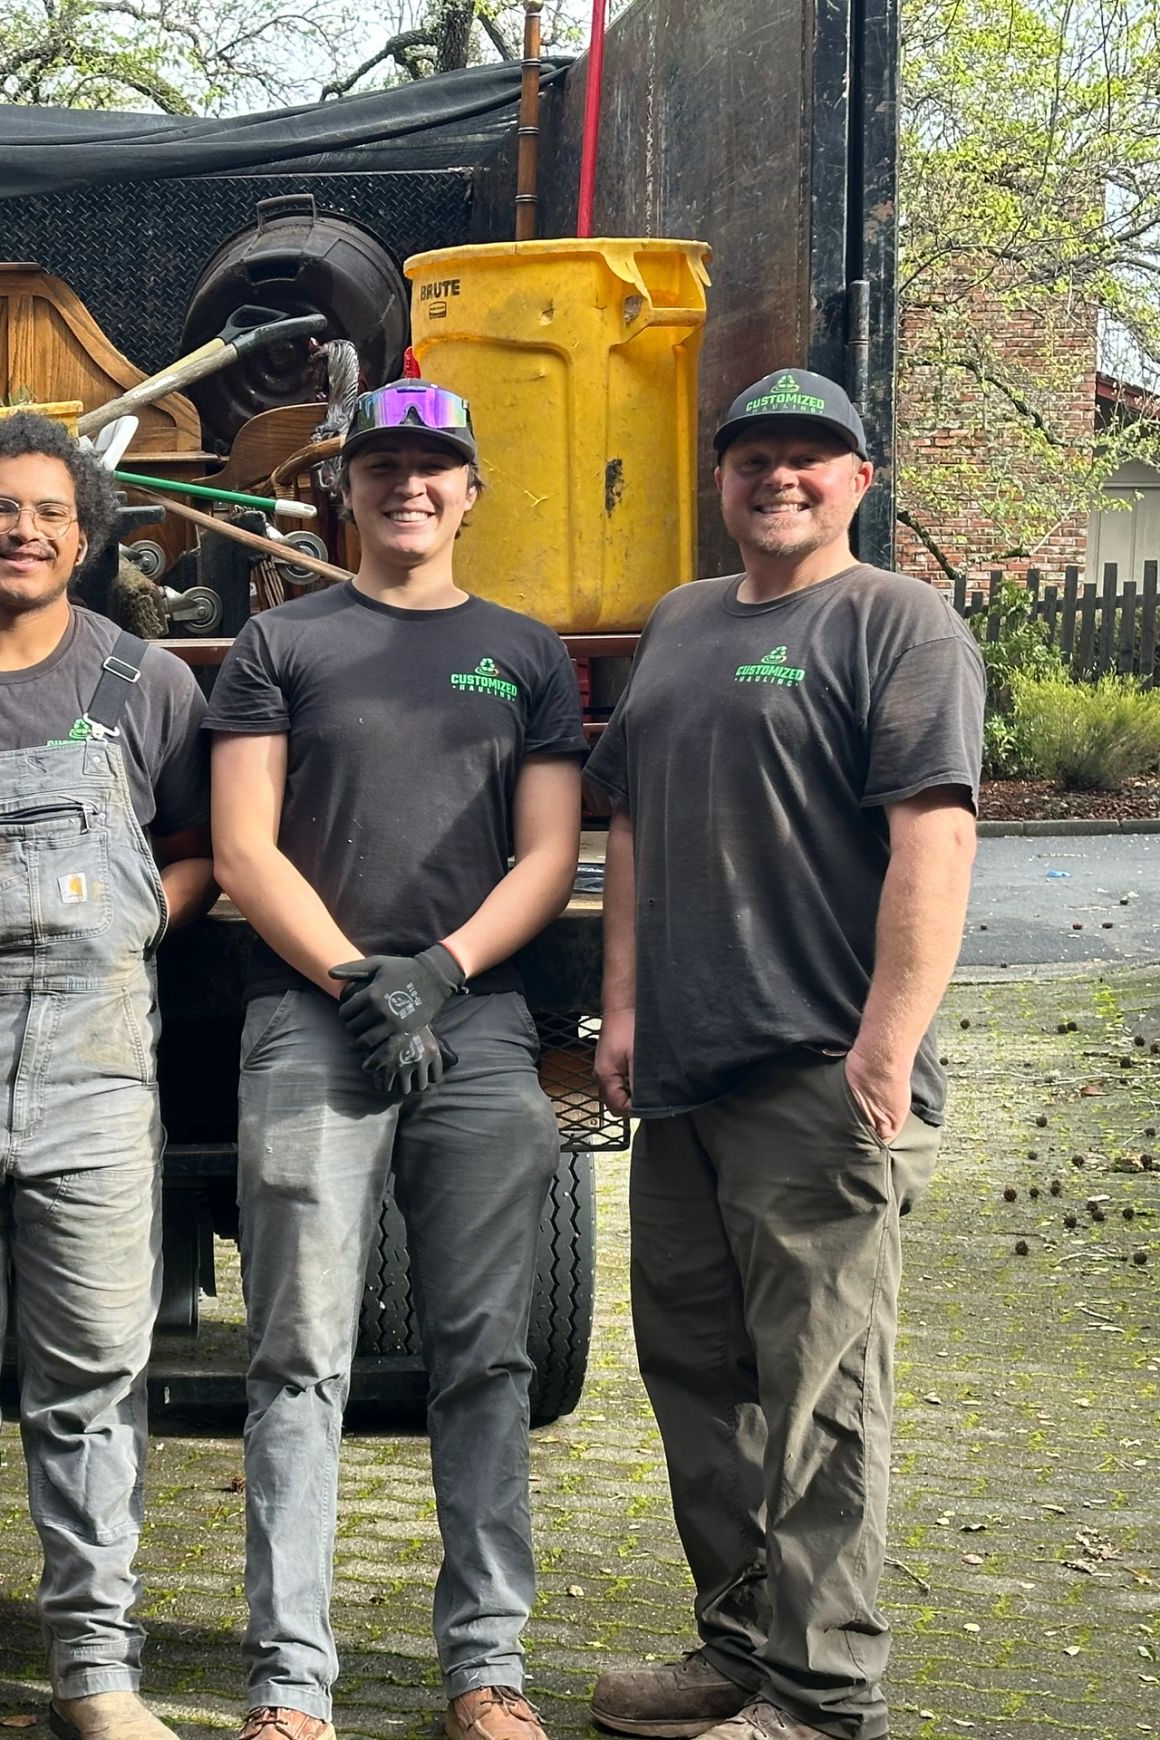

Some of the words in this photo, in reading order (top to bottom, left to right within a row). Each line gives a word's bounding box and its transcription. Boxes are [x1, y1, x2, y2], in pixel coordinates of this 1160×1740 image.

[420, 279, 460, 301] BRUTE
[746, 394, 825, 412] CUSTOMIZED
[735, 665, 806, 681] CUSTOMIZED
[738, 675, 793, 687] HAULING
[450, 673, 518, 697] CUSTOMIZED
[459, 684, 511, 701] HAULING
